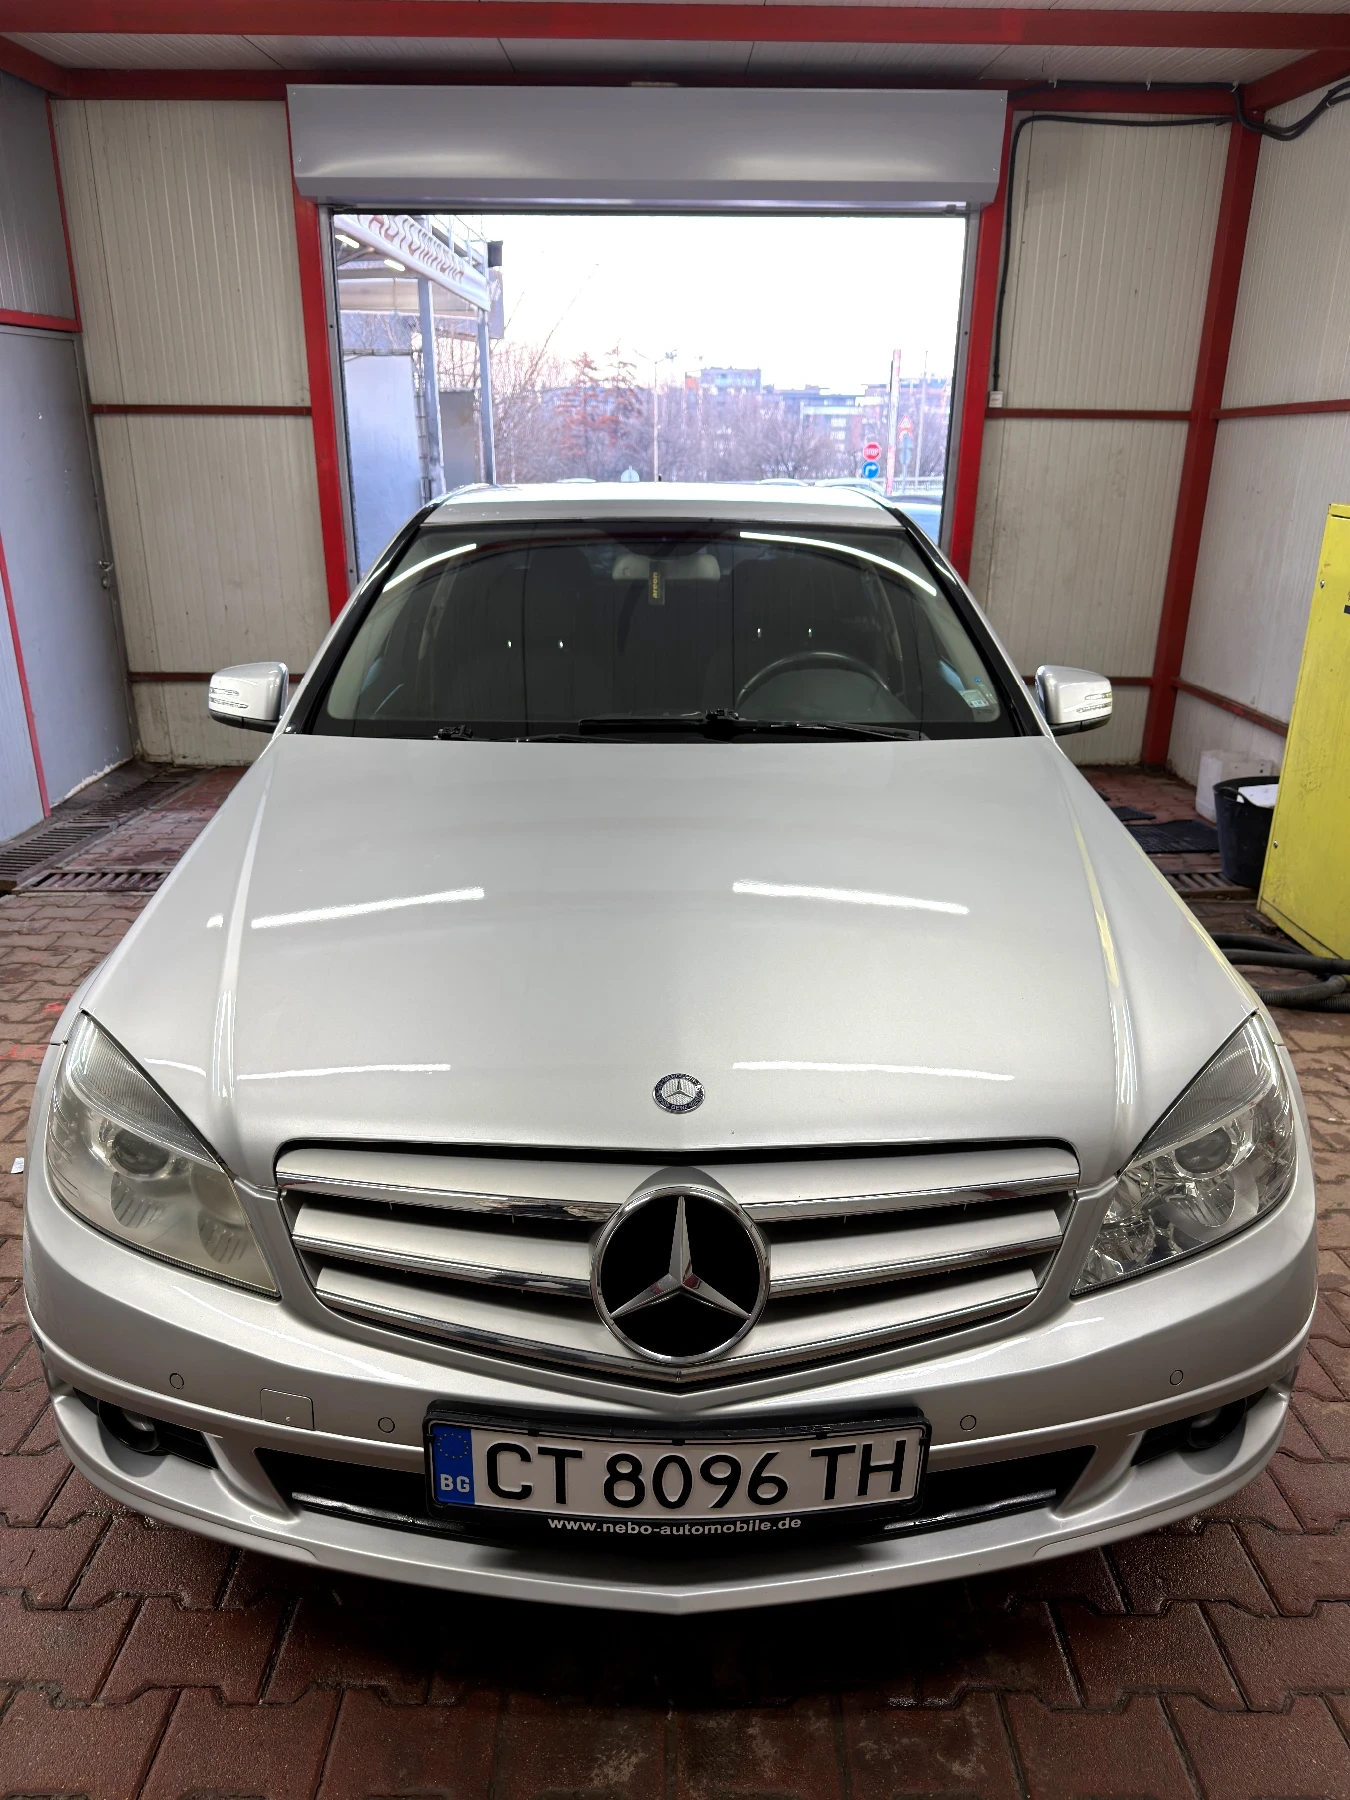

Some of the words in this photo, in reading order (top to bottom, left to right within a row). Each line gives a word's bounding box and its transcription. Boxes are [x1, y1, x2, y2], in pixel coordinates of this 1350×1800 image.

[440, 1473, 470, 1493] BG
[487, 1442, 583, 1504] CT
[603, 1451, 788, 1509] 8096
[810, 1440, 906, 1500] TH
[548, 1517, 801, 1535] www.nebo-automobile.de
